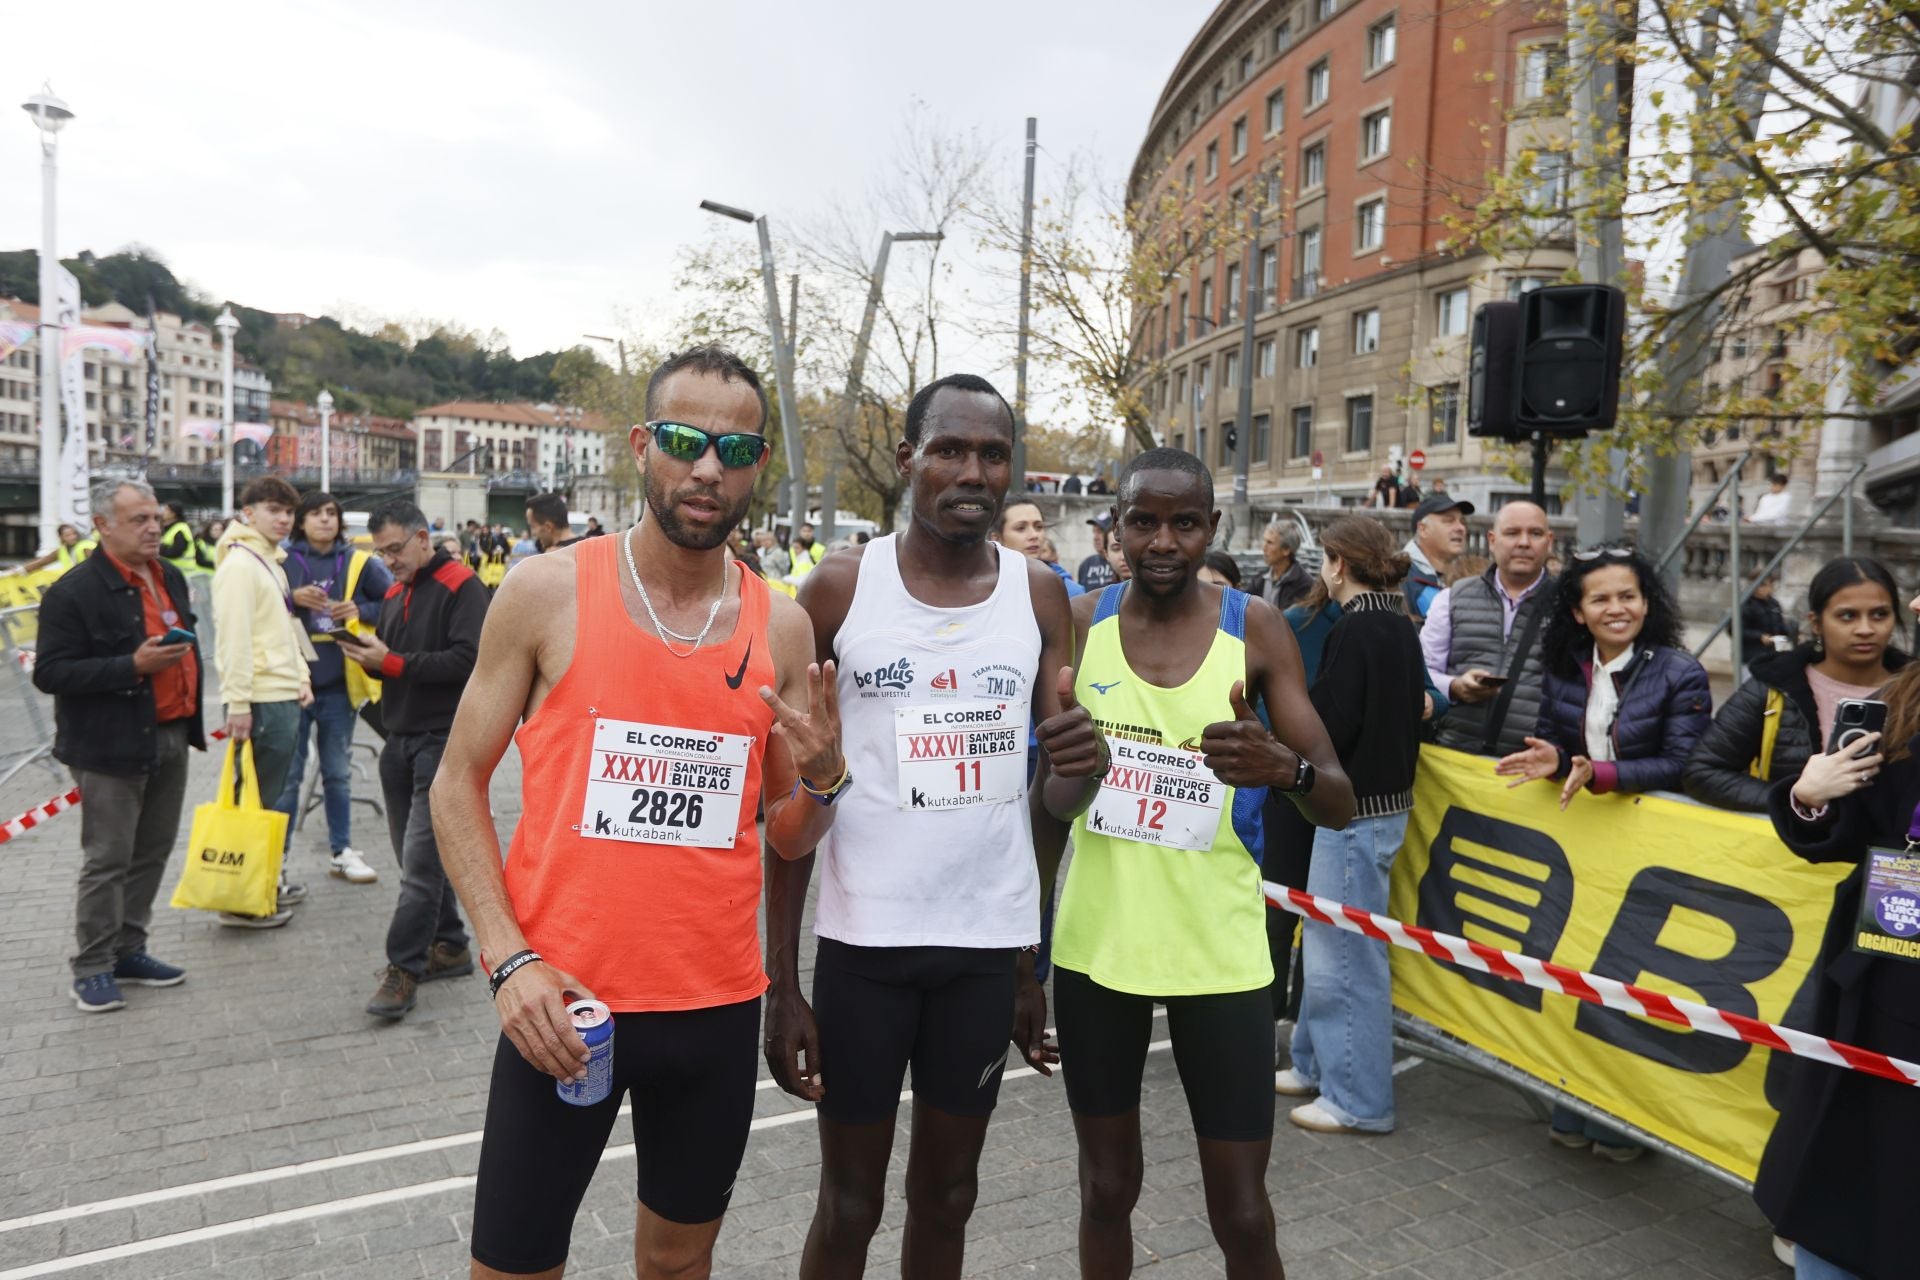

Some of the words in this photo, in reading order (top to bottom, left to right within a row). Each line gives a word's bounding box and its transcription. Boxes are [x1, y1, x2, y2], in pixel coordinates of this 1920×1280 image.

[1087, 564, 1114, 578] POL
[854, 670, 872, 688] be
[874, 662, 914, 688] plus
[972, 665, 991, 679] TEAM
[992, 664, 1022, 678] MANAGER
[988, 677, 1003, 694] TM
[1005, 680, 1016, 696] 10
[923, 713, 942, 724] EL
[944, 709, 1002, 723] CORREO
[626, 731, 646, 745] EL
[650, 734, 718, 753] CORREO
[969, 730, 1016, 743] SANTURCE
[908, 734, 964, 759] XXXVI
[969, 740, 1015, 755] BILBAO
[1117, 746, 1135, 759] EL
[1137, 750, 1196, 770] CORREO
[601, 753, 668, 785] XXXVI
[674, 762, 732, 778] SANTURCE
[955, 760, 981, 792] 11
[672, 773, 730, 790] BILBAO
[1102, 765, 1152, 793] XXVI
[1156, 775, 1211, 792] SANTURCE
[927, 793, 984, 807] kutxabank
[1154, 784, 1209, 803] BILBAO
[628, 788, 704, 829] 2826
[1136, 797, 1167, 831] 12
[613, 824, 682, 842] kutxabank
[1104, 820, 1161, 842] kutxabank
[1890, 896, 1916, 908] SAN
[1575, 866, 1817, 1108] B
